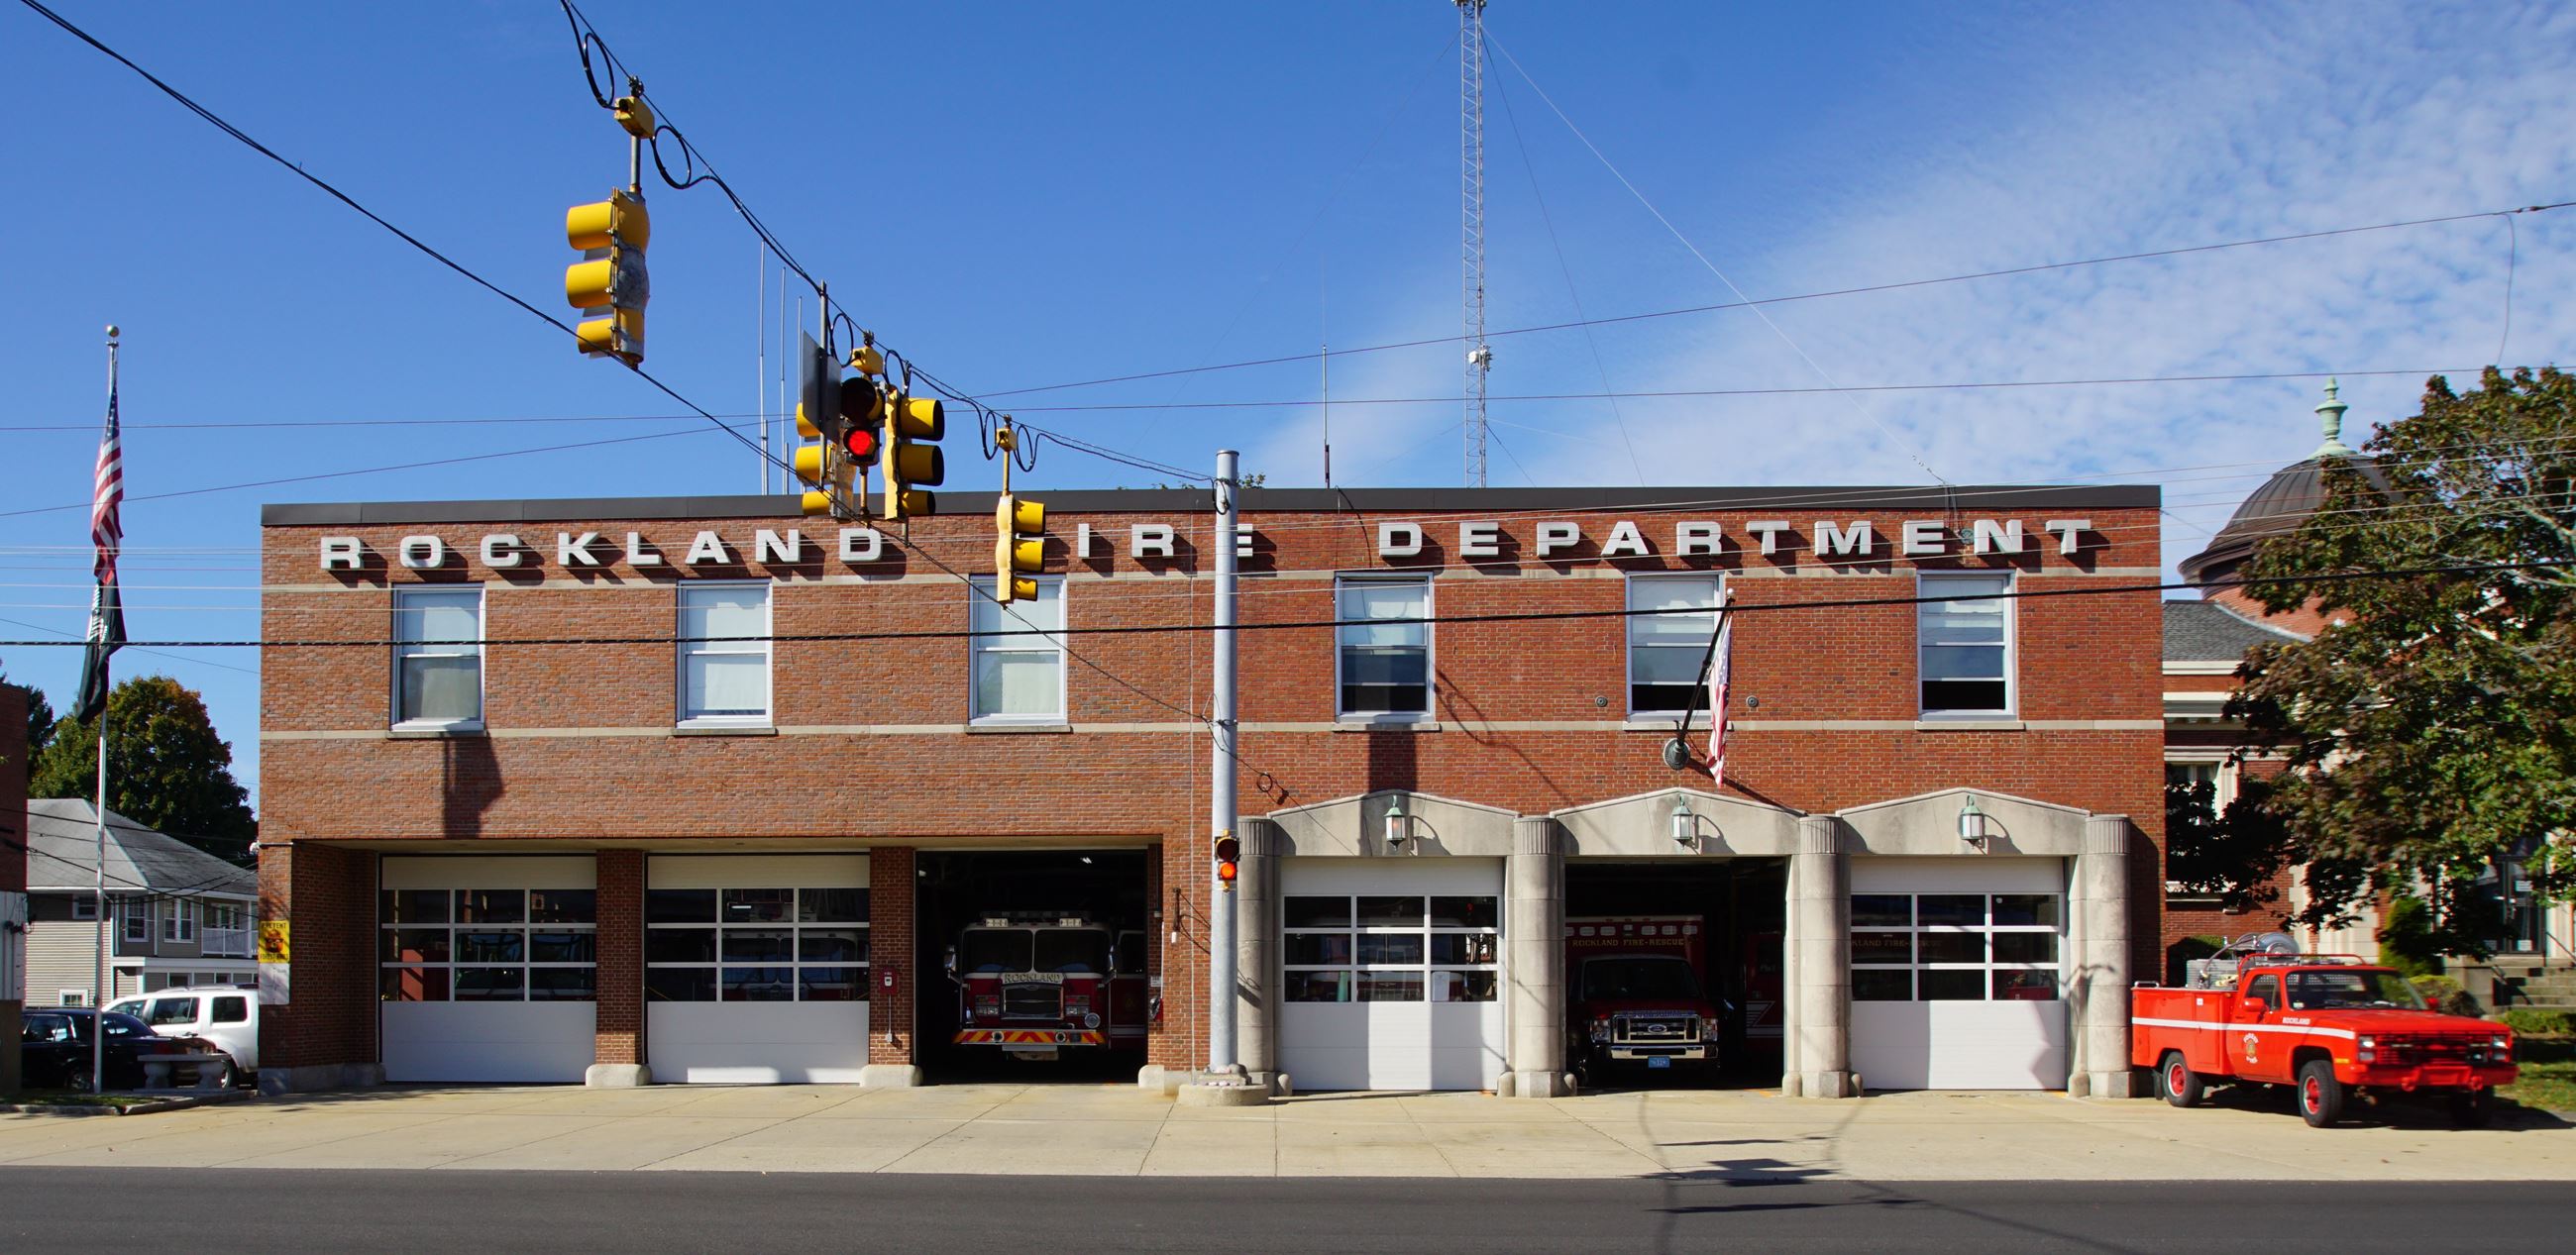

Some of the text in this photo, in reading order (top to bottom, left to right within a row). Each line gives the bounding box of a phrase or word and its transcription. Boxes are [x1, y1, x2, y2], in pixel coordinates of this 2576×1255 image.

[320, 519, 2092, 569] ROCKLAND IR DEPARTMENT
[1571, 938, 1619, 947] ROCKLAND
[1004, 973, 1060, 984] ROCKLAND
